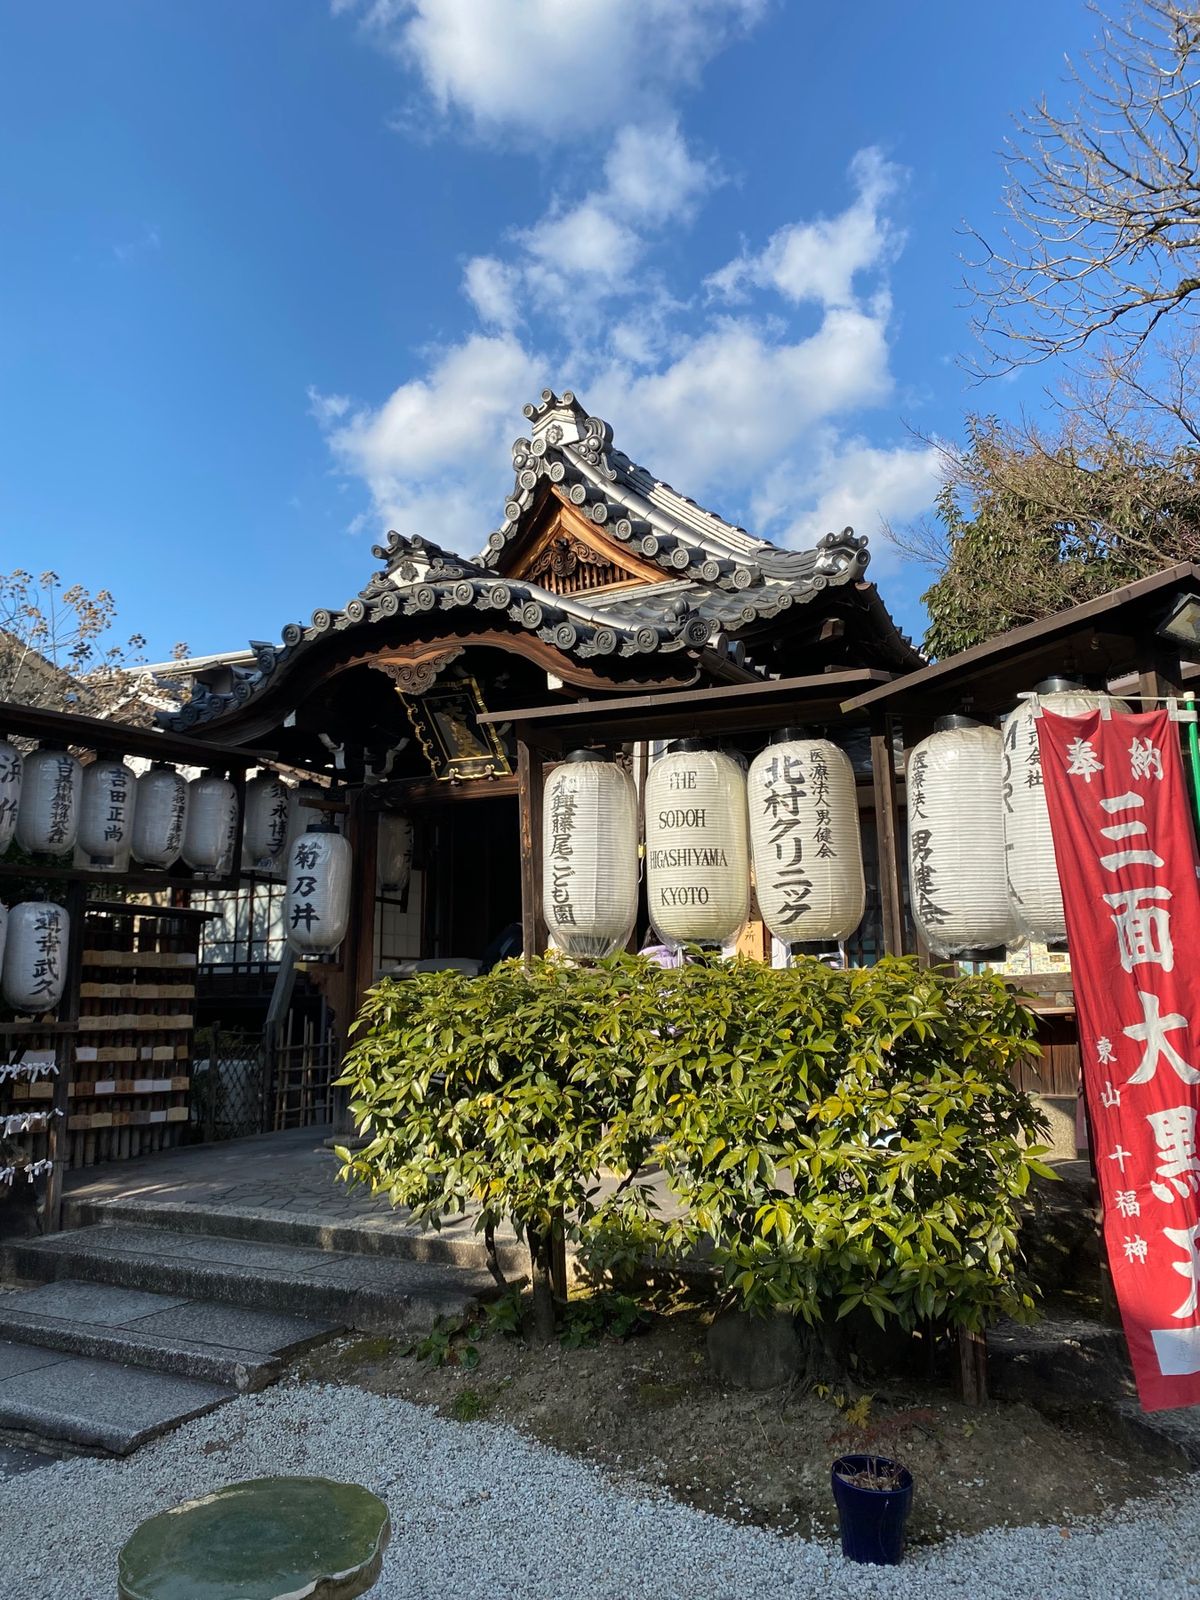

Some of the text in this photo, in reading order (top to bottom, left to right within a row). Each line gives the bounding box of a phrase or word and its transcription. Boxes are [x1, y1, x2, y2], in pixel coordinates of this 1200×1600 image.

[667, 771, 697, 790] THE
[1066, 737, 1164, 783] 奉納
[104, 767, 129, 843] 吉田正尚
[266, 782, 289, 855] 須永博子
[659, 808, 706, 829] SODOH
[763, 755, 813, 925] 北村クリニック
[808, 748, 837, 858] 医療法人男健会
[911, 750, 953, 925] 医療法人男健会
[290, 842, 322, 933] 菊乃井
[550, 775, 579, 926] 永興藤尾こども園
[650, 848, 728, 870] HIGASHIYAMA
[660, 887, 709, 906] KYOTO
[29, 909, 62, 997] 道幸武久
[1096, 1036, 1149, 1264] 東山十福神
